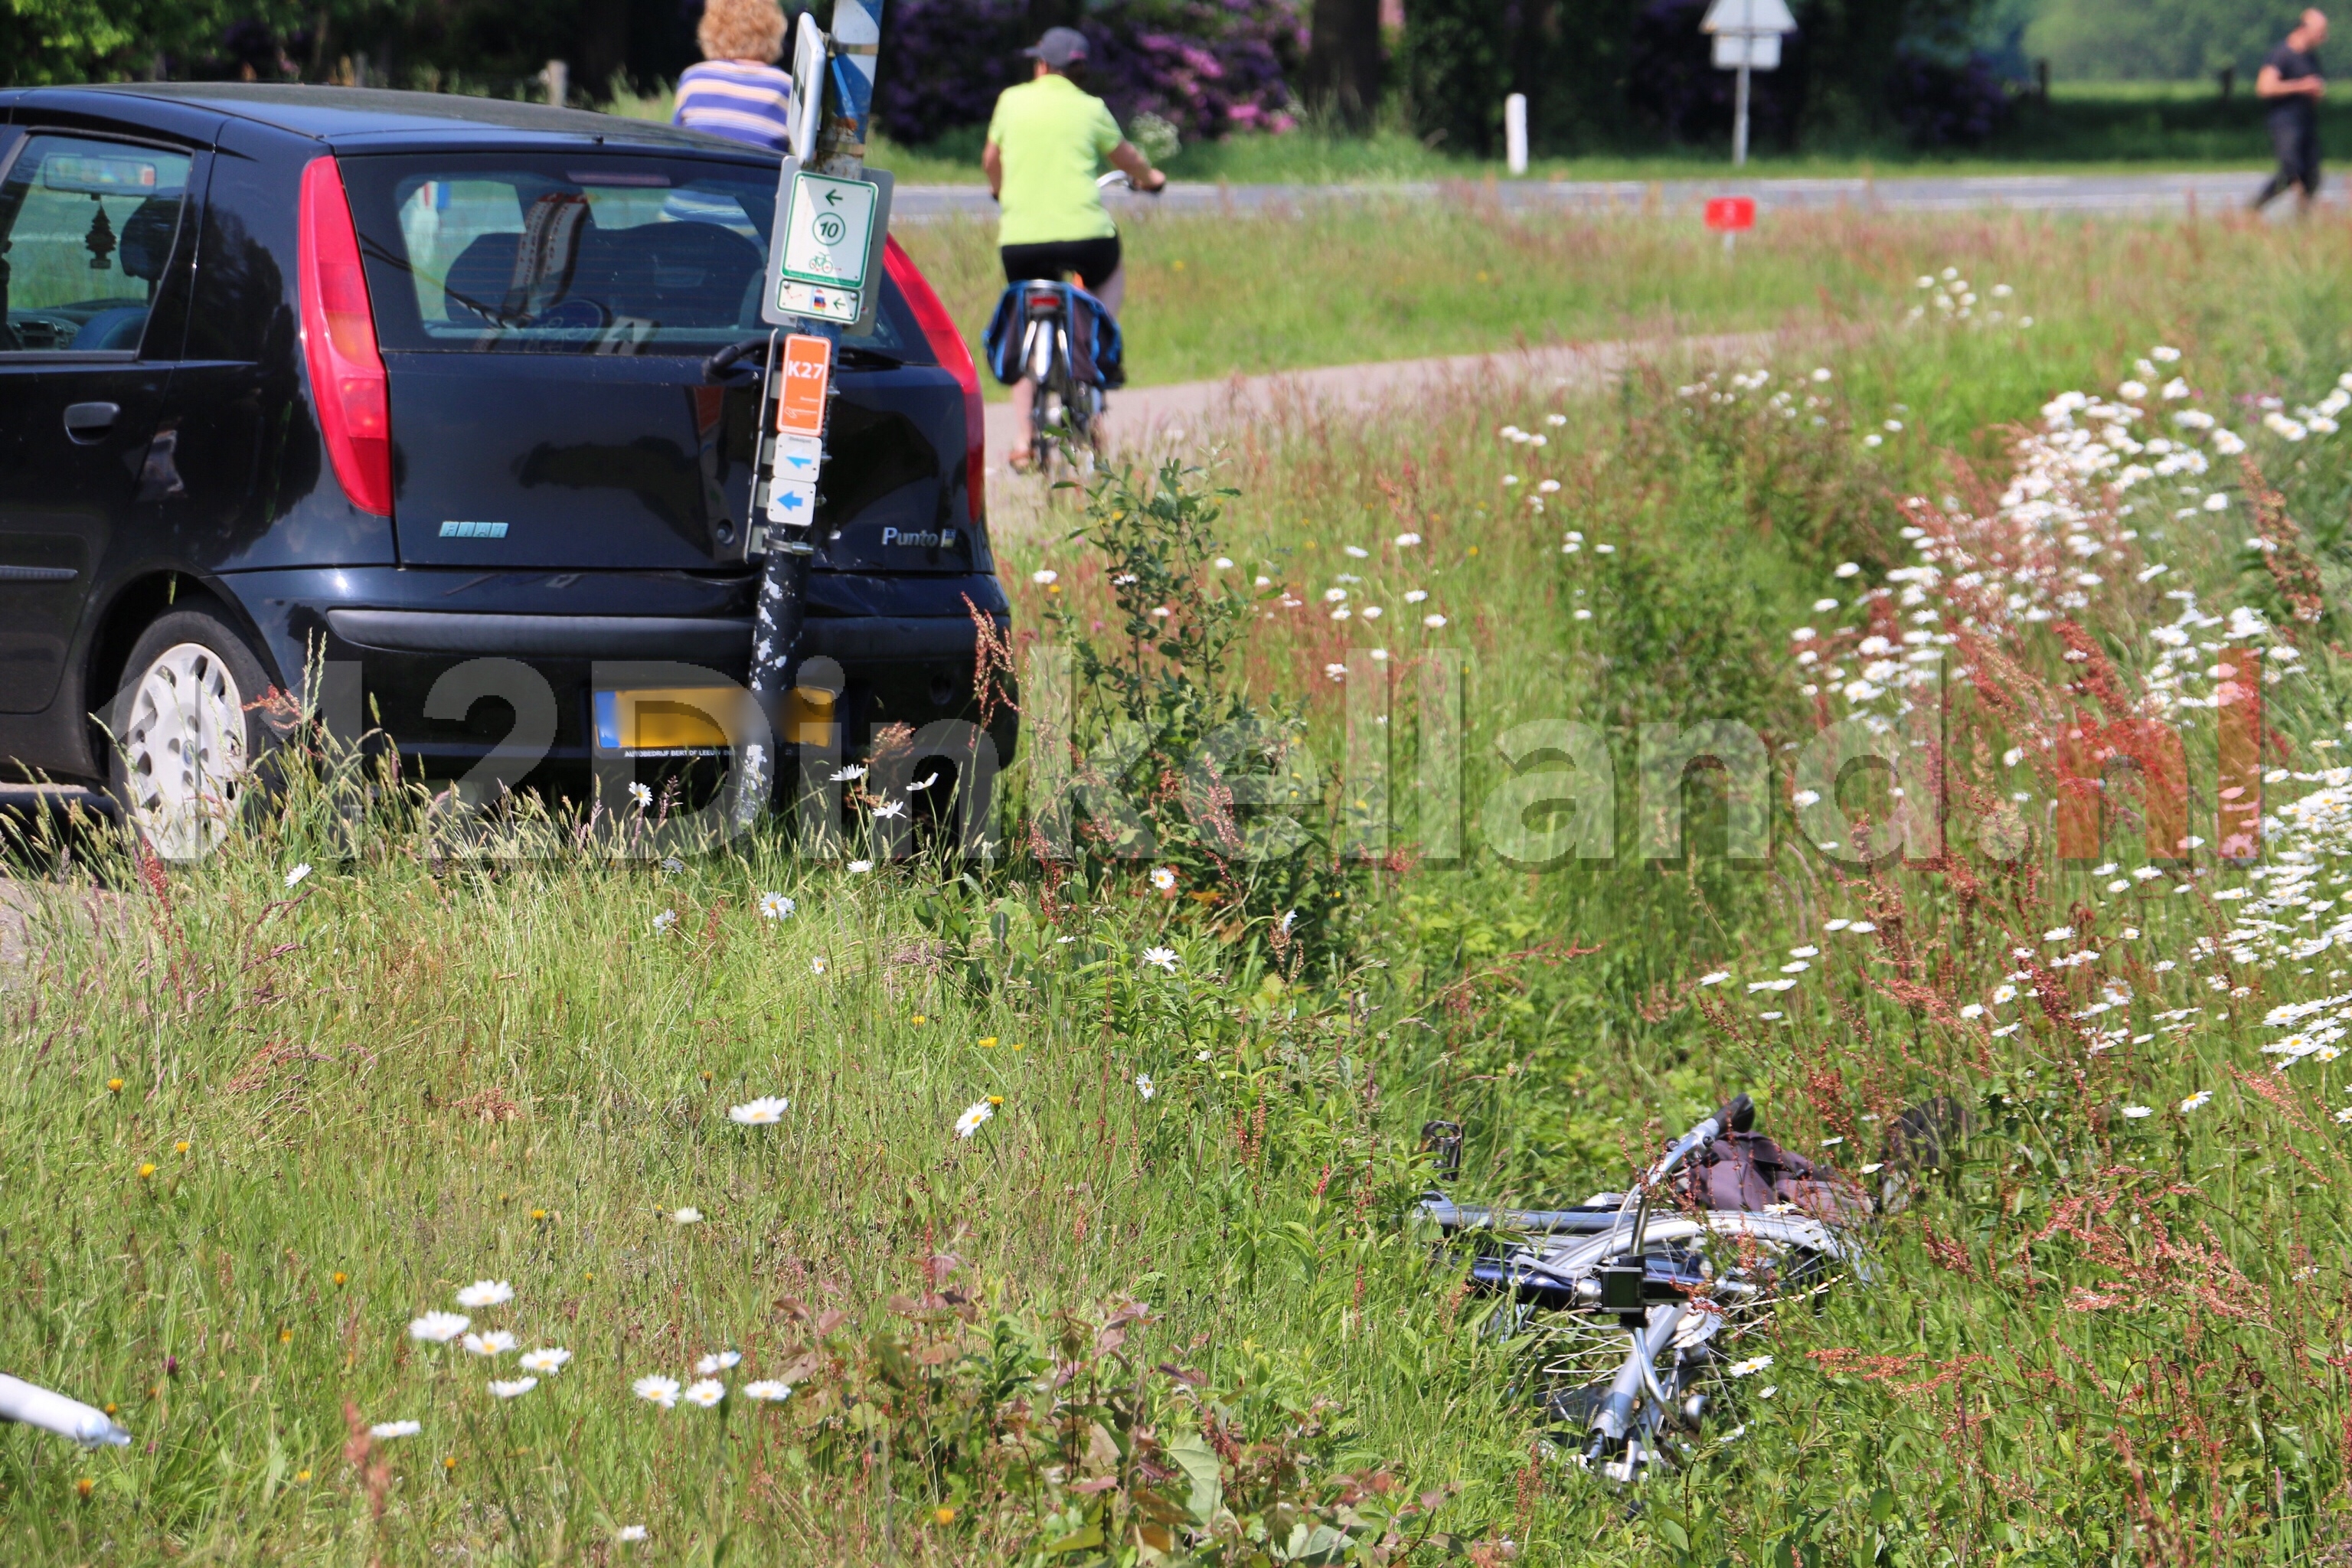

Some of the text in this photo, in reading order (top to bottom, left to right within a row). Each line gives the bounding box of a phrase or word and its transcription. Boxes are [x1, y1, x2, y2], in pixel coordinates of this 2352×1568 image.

[820, 220, 839, 238] 10
[787, 360, 825, 380] K27
[442, 522, 507, 537] FIAT
[881, 527, 939, 547] Punto
